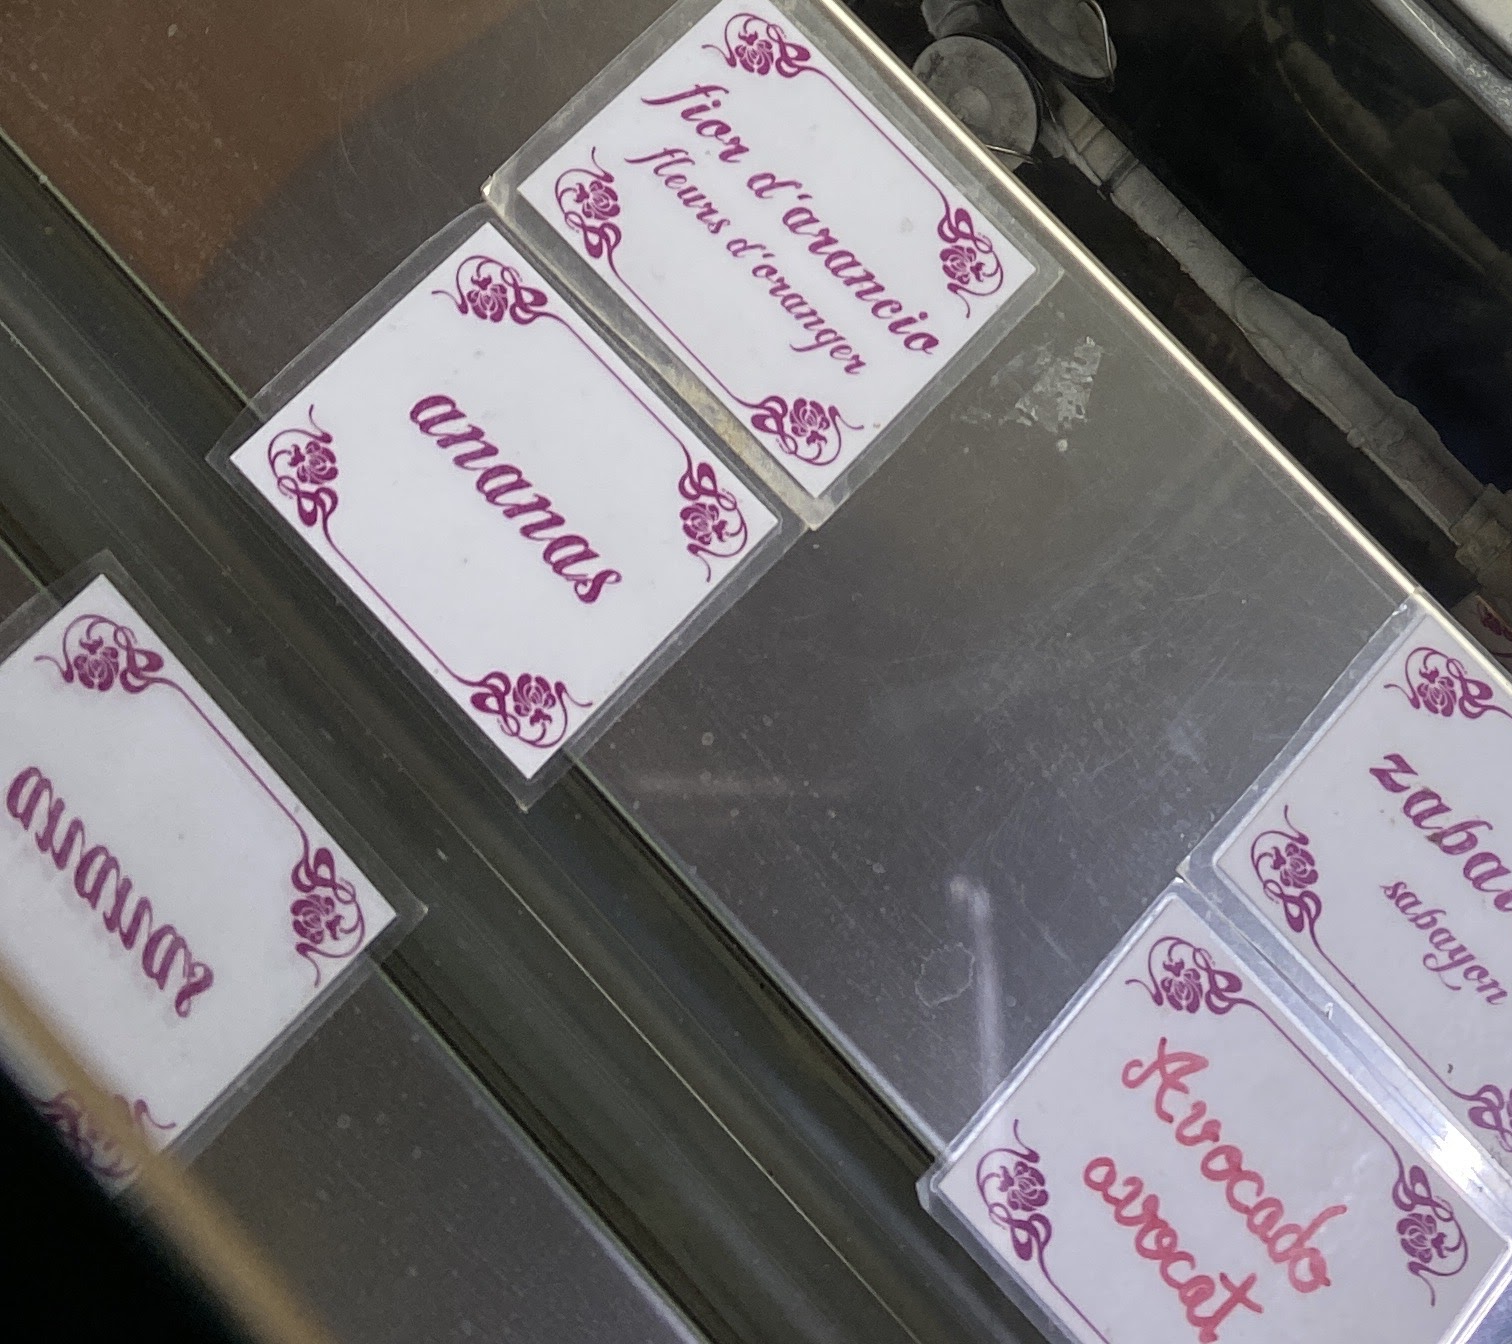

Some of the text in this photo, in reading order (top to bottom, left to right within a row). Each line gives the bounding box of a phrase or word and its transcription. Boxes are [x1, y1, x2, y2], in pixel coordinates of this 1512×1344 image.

[623, 147, 867, 375] fleurs d'oranger
[640, 83, 940, 355] fior d'arancio
[409, 394, 622, 604] ananas
[1379, 881, 1508, 1006] sabayon
[1083, 1155, 1265, 1344] avocat
[1121, 1036, 1348, 1294] Avocado
